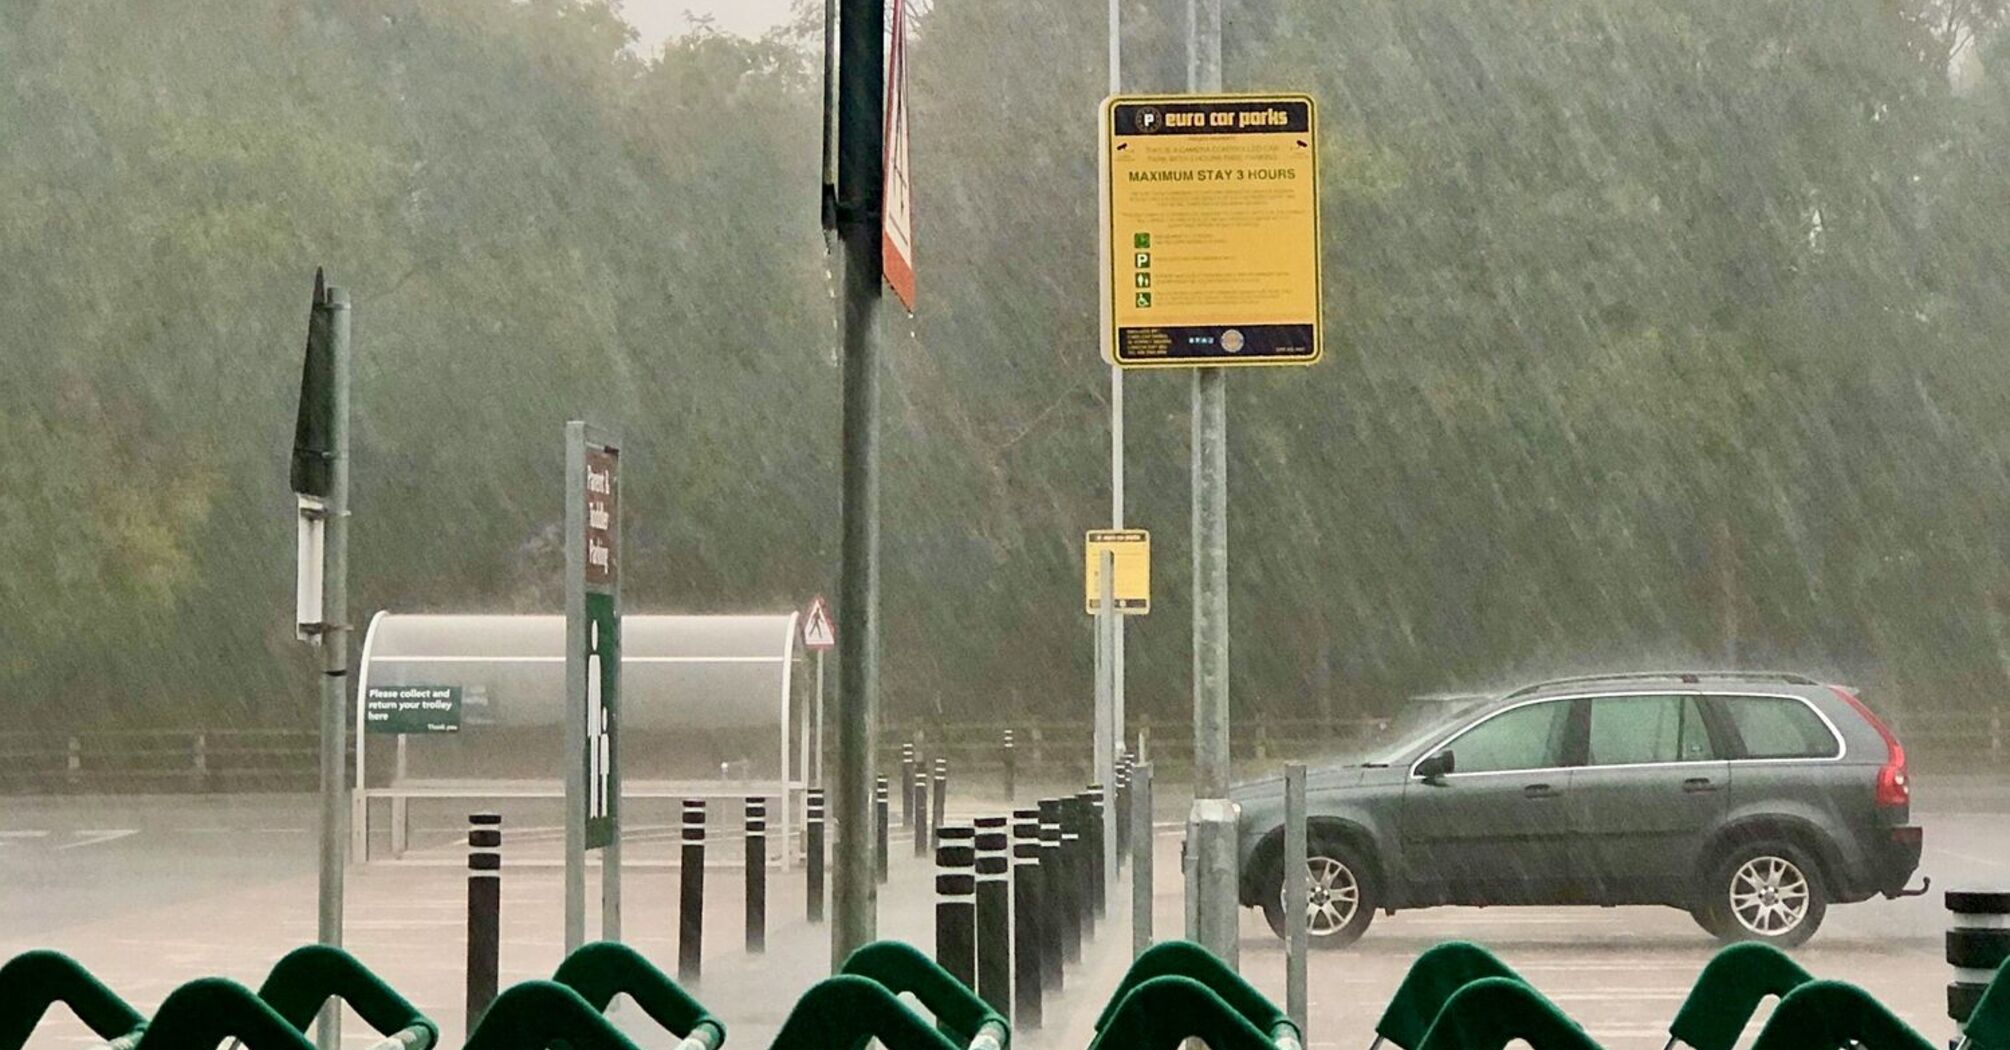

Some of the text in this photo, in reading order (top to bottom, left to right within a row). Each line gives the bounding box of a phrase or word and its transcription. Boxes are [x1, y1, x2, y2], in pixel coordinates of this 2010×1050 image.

[1144, 108, 1288, 128] P euro car parks
[1129, 168, 1296, 182] MAXIMUM STAY 3 HOURS
[369, 689, 450, 699] Please collect and
[368, 700, 452, 712] return your trolley
[368, 712, 389, 721] here
